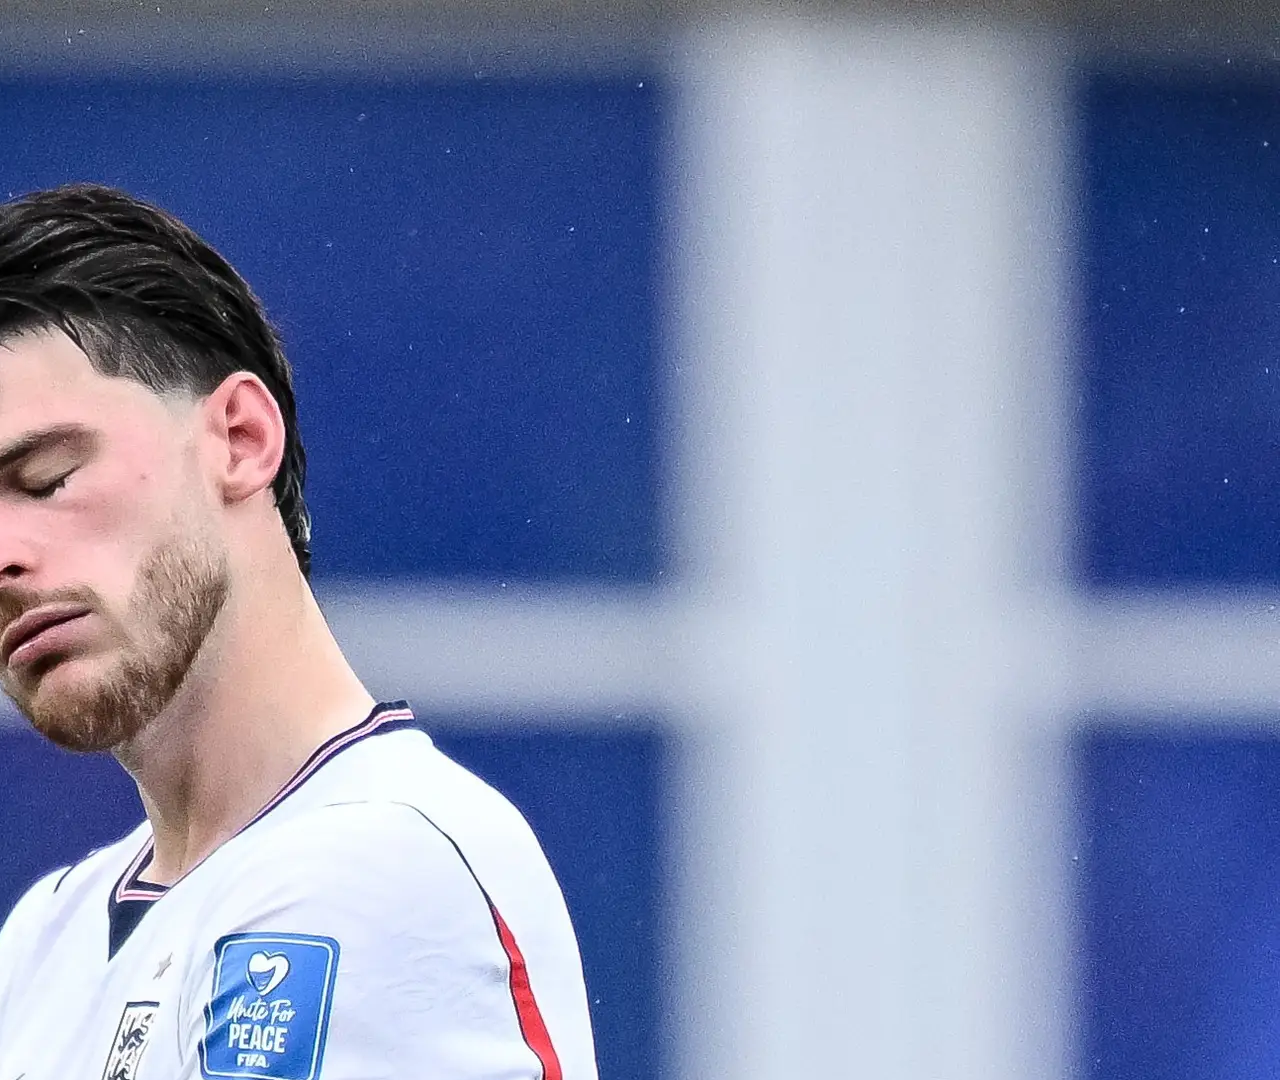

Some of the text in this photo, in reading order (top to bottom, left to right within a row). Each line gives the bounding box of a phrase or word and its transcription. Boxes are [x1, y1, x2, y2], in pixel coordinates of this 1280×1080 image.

[226, 995, 296, 1025] Unite For
[228, 1023, 288, 1054] PEACE
[237, 1053, 267, 1067] FIFA
